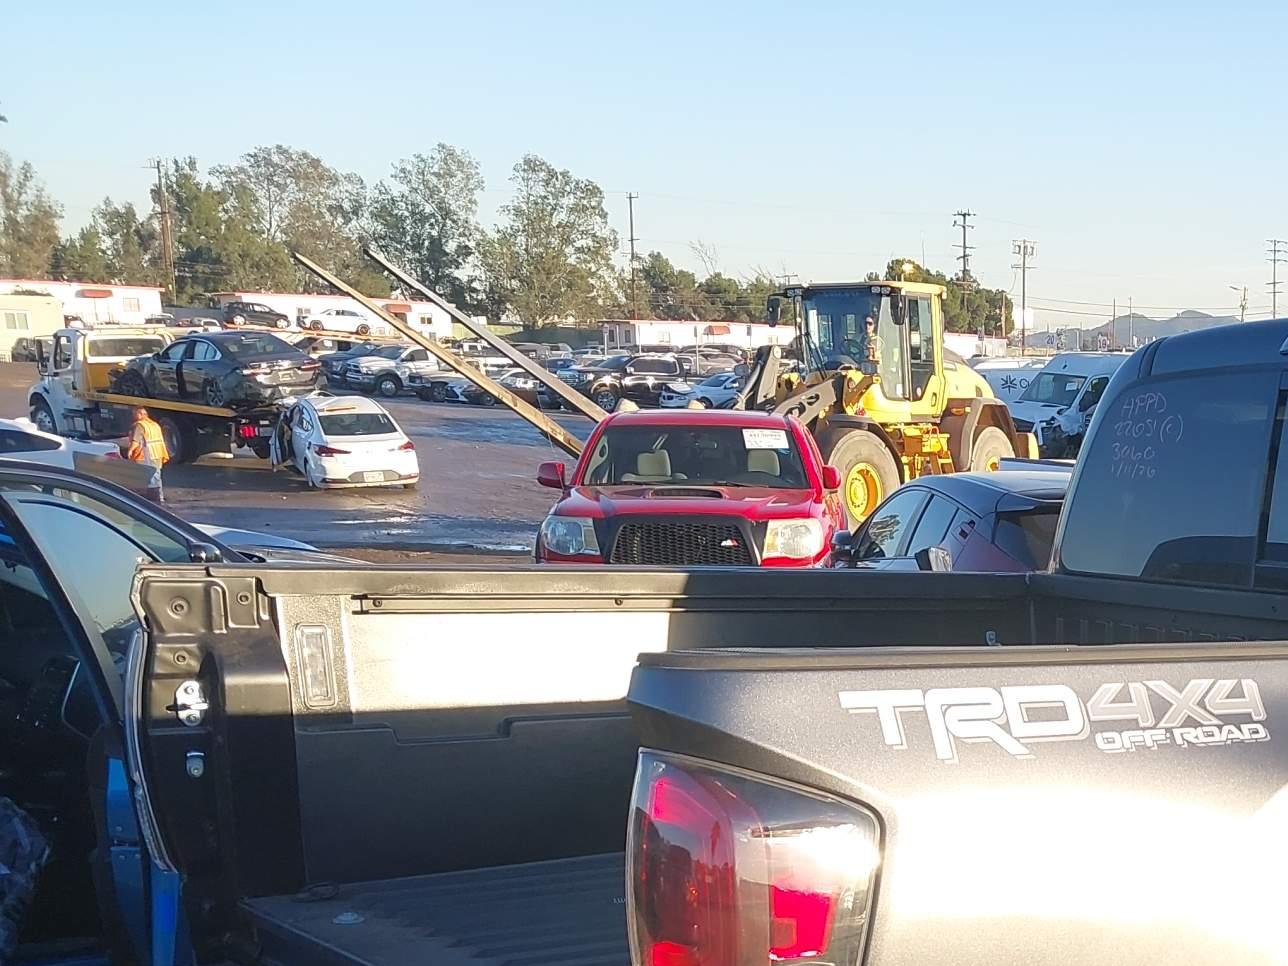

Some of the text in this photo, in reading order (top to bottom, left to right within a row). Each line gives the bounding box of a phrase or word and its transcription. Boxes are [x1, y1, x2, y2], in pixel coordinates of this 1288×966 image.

[838, 684, 1090, 765] TRD
[1095, 724, 1270, 753] OFF ROAD
